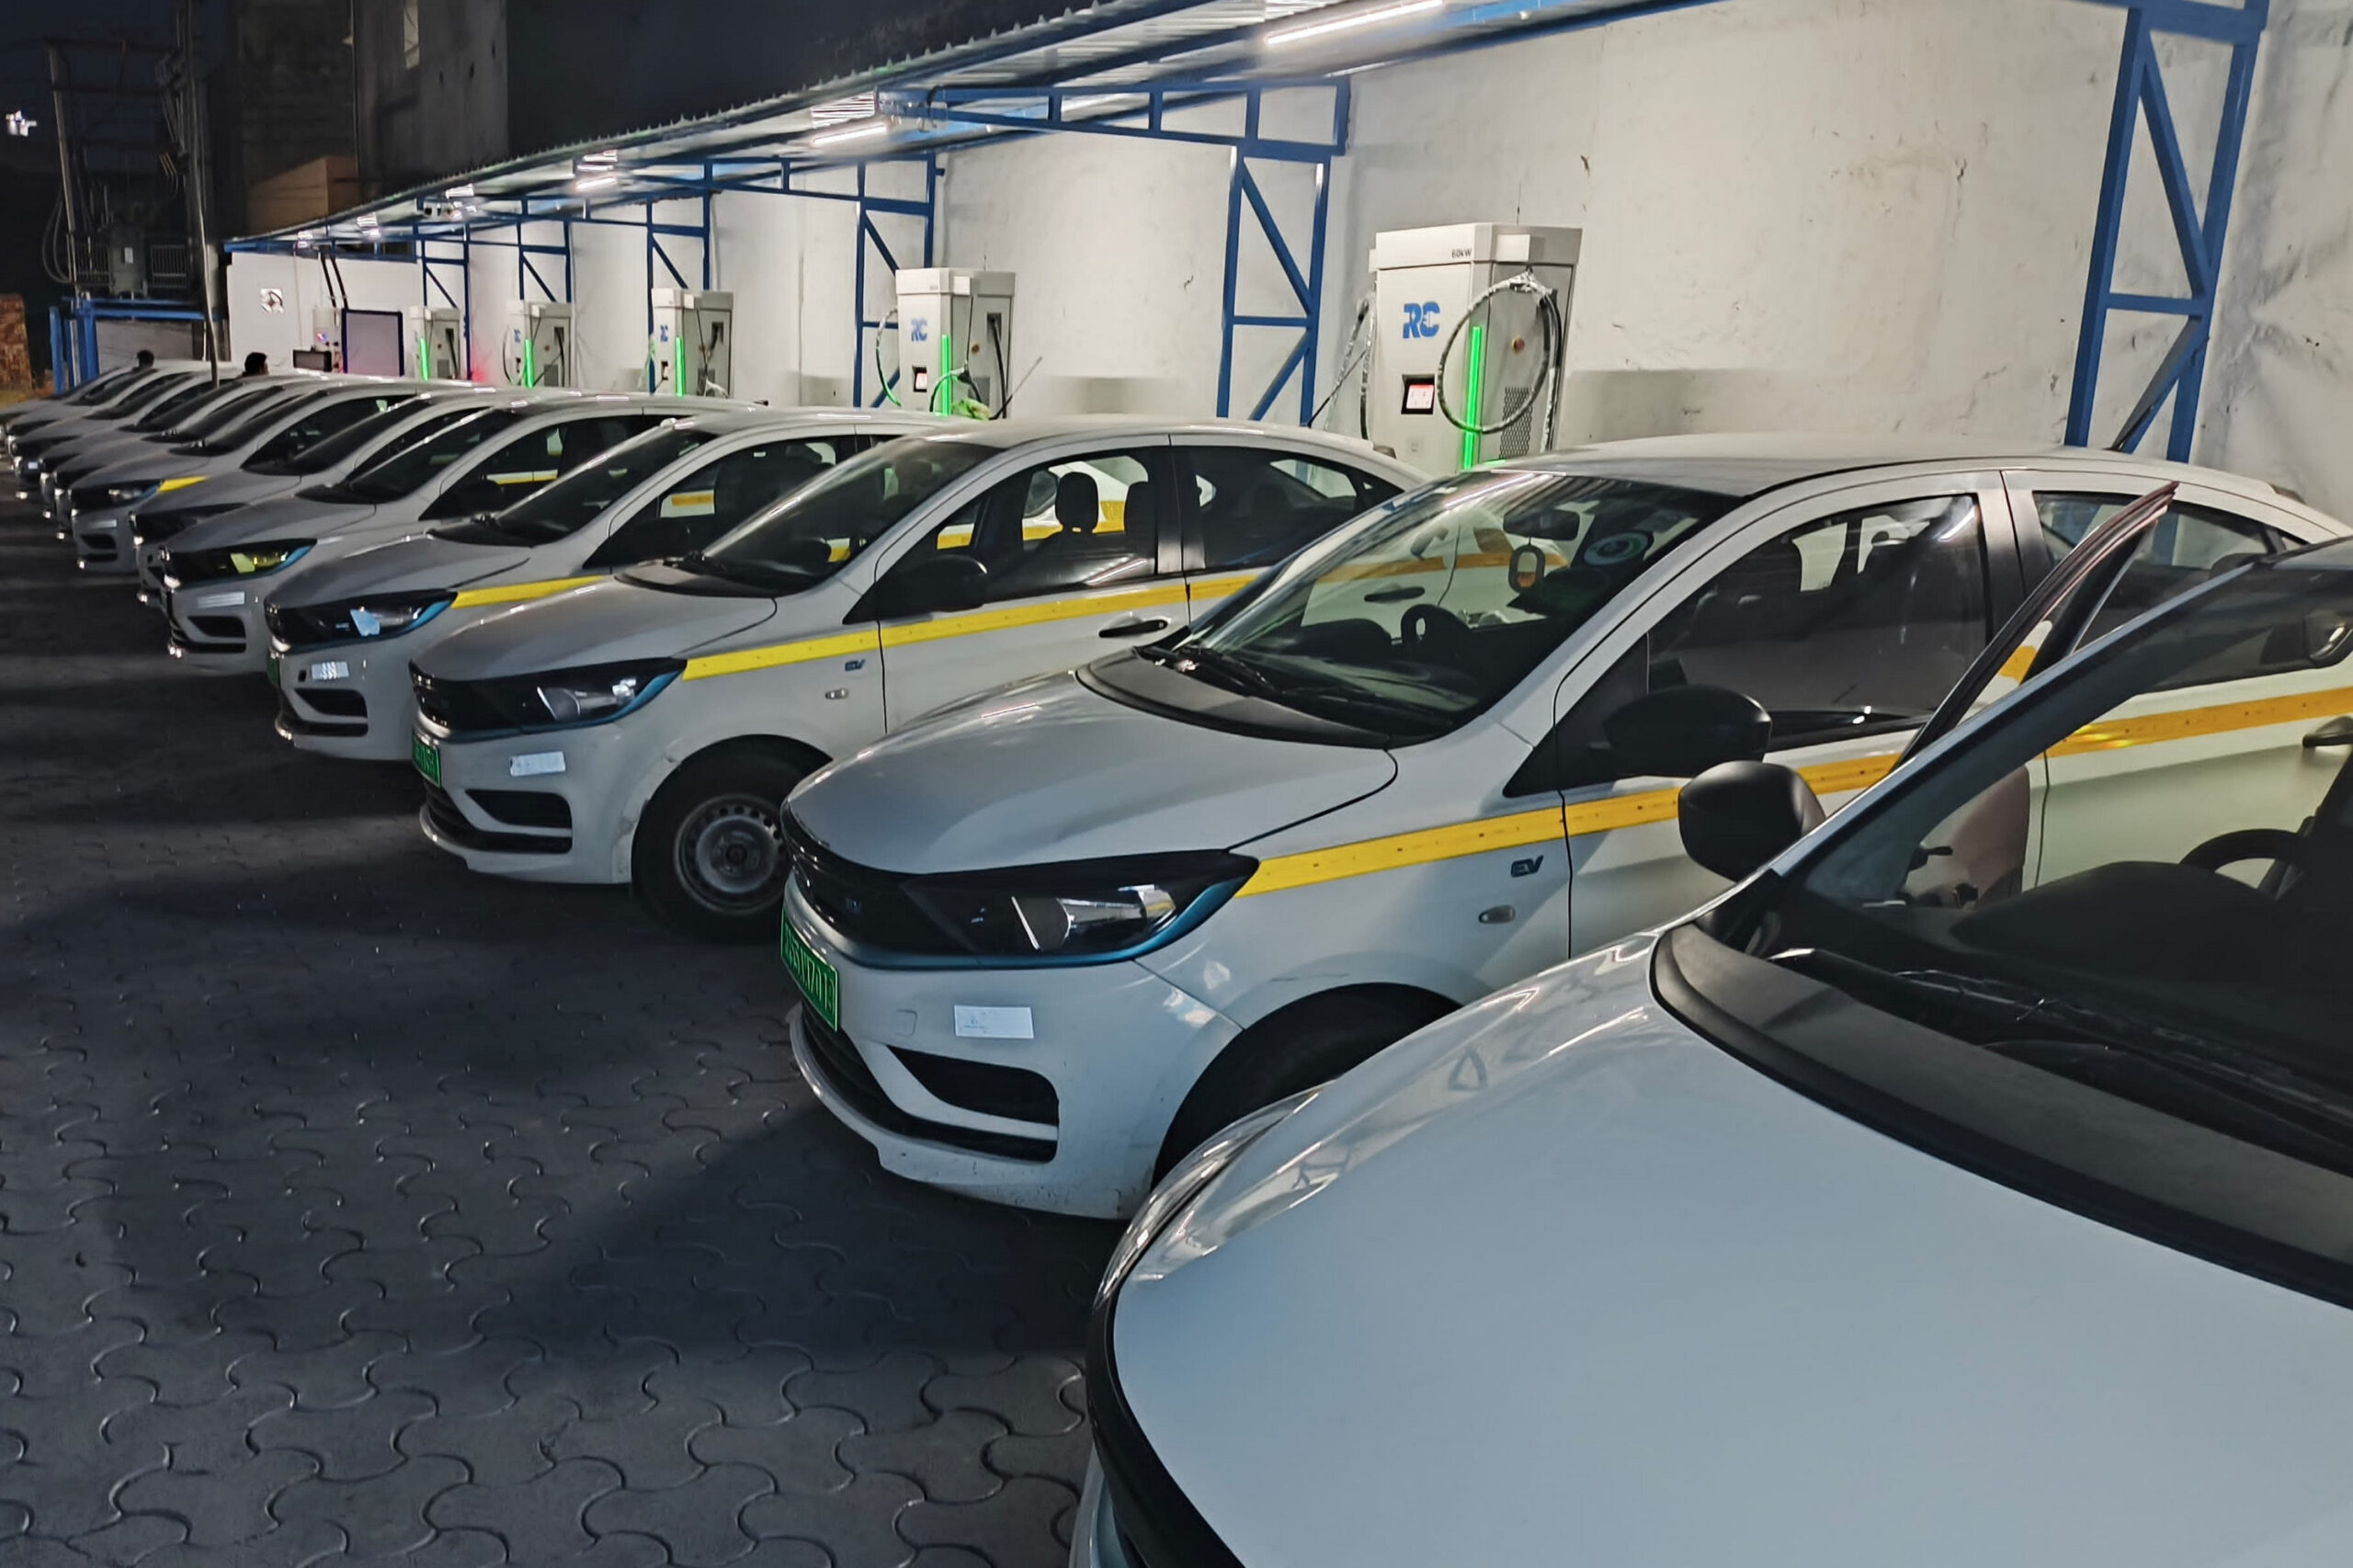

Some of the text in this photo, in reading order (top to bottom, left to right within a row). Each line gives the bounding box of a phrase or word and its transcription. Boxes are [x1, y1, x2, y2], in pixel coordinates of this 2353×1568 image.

[1451, 247, 1472, 258] 60kW
[1402, 301, 1441, 339] RC
[1510, 854, 1545, 878] EV
